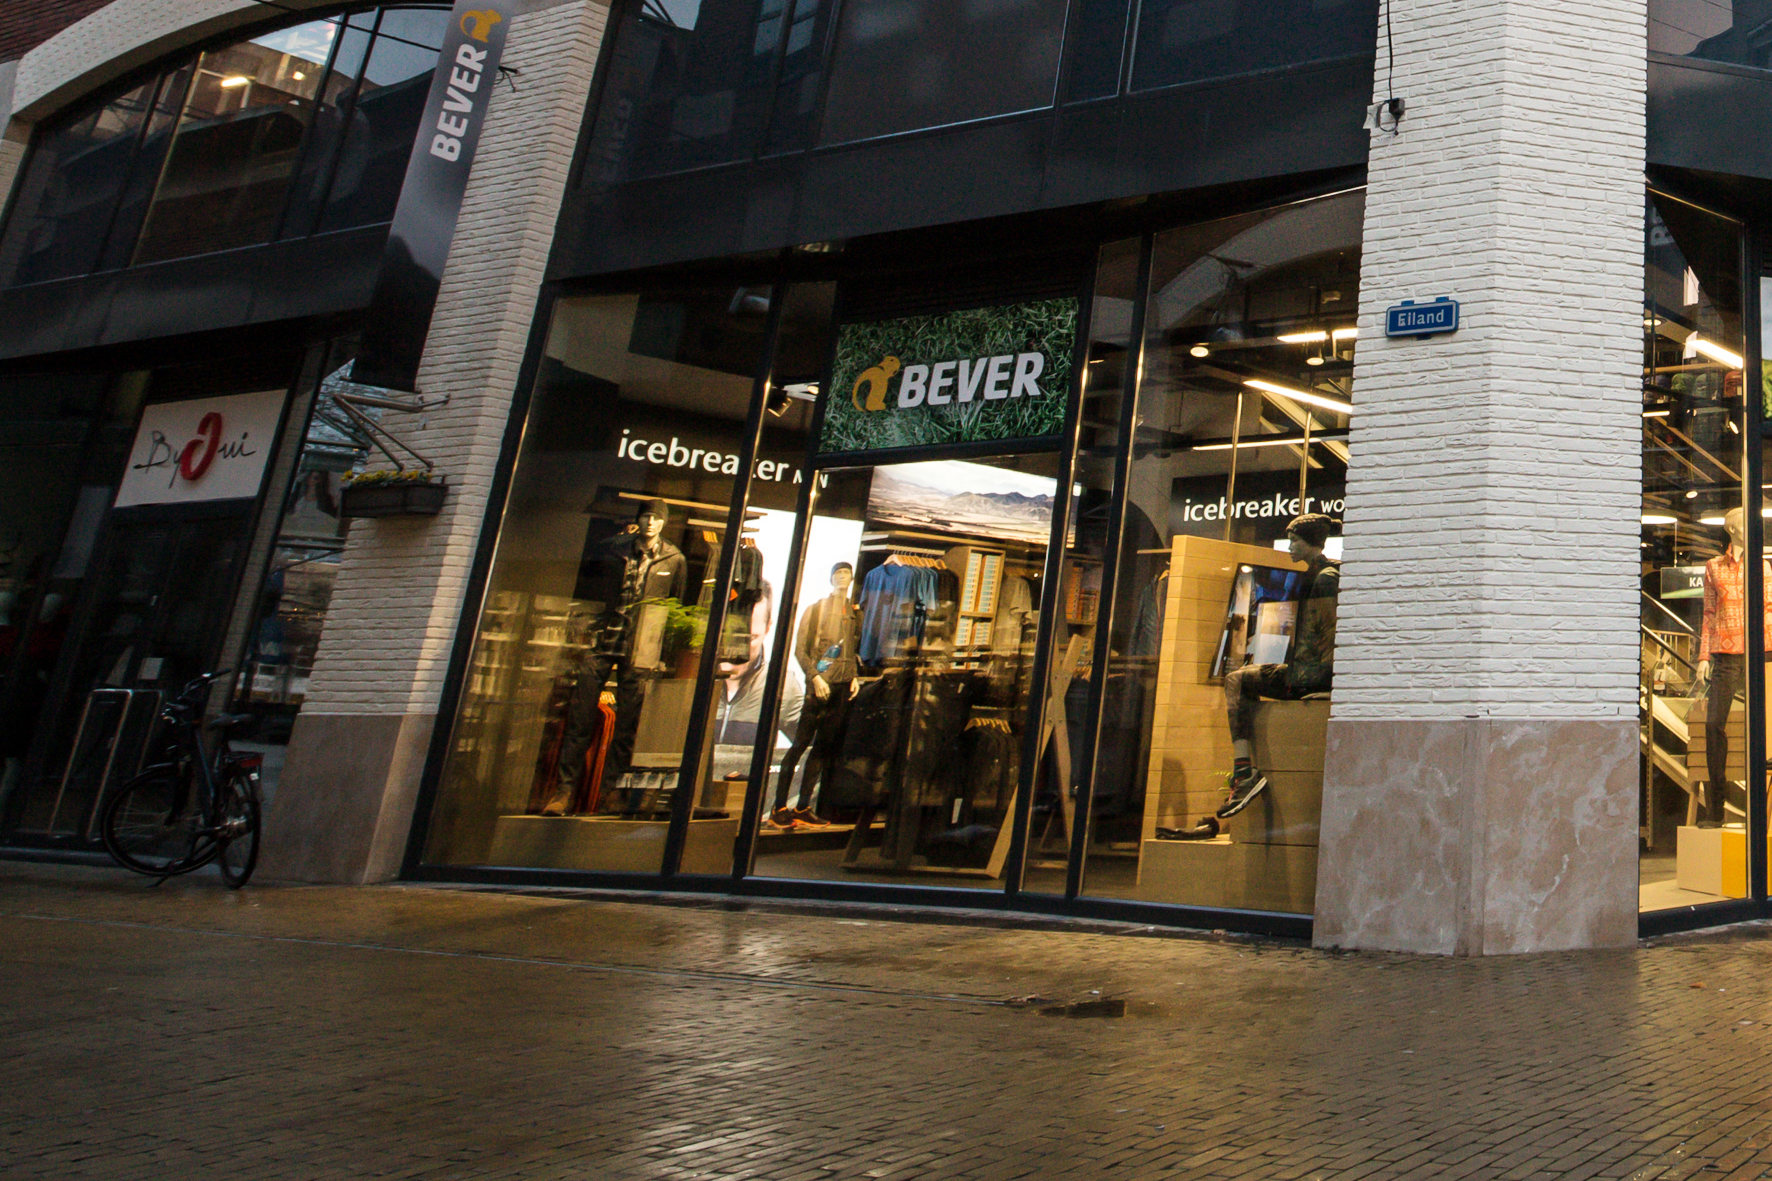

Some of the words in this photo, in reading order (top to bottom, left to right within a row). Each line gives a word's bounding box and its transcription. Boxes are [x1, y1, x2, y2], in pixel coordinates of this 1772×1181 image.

[430, 43, 488, 162] BEVER
[1398, 309, 1445, 327] Eiland
[898, 352, 1044, 408] BEVER
[618, 429, 790, 483] icebreaer
[793, 469, 829, 489] MN
[1184, 493, 1315, 522] icebreaker
